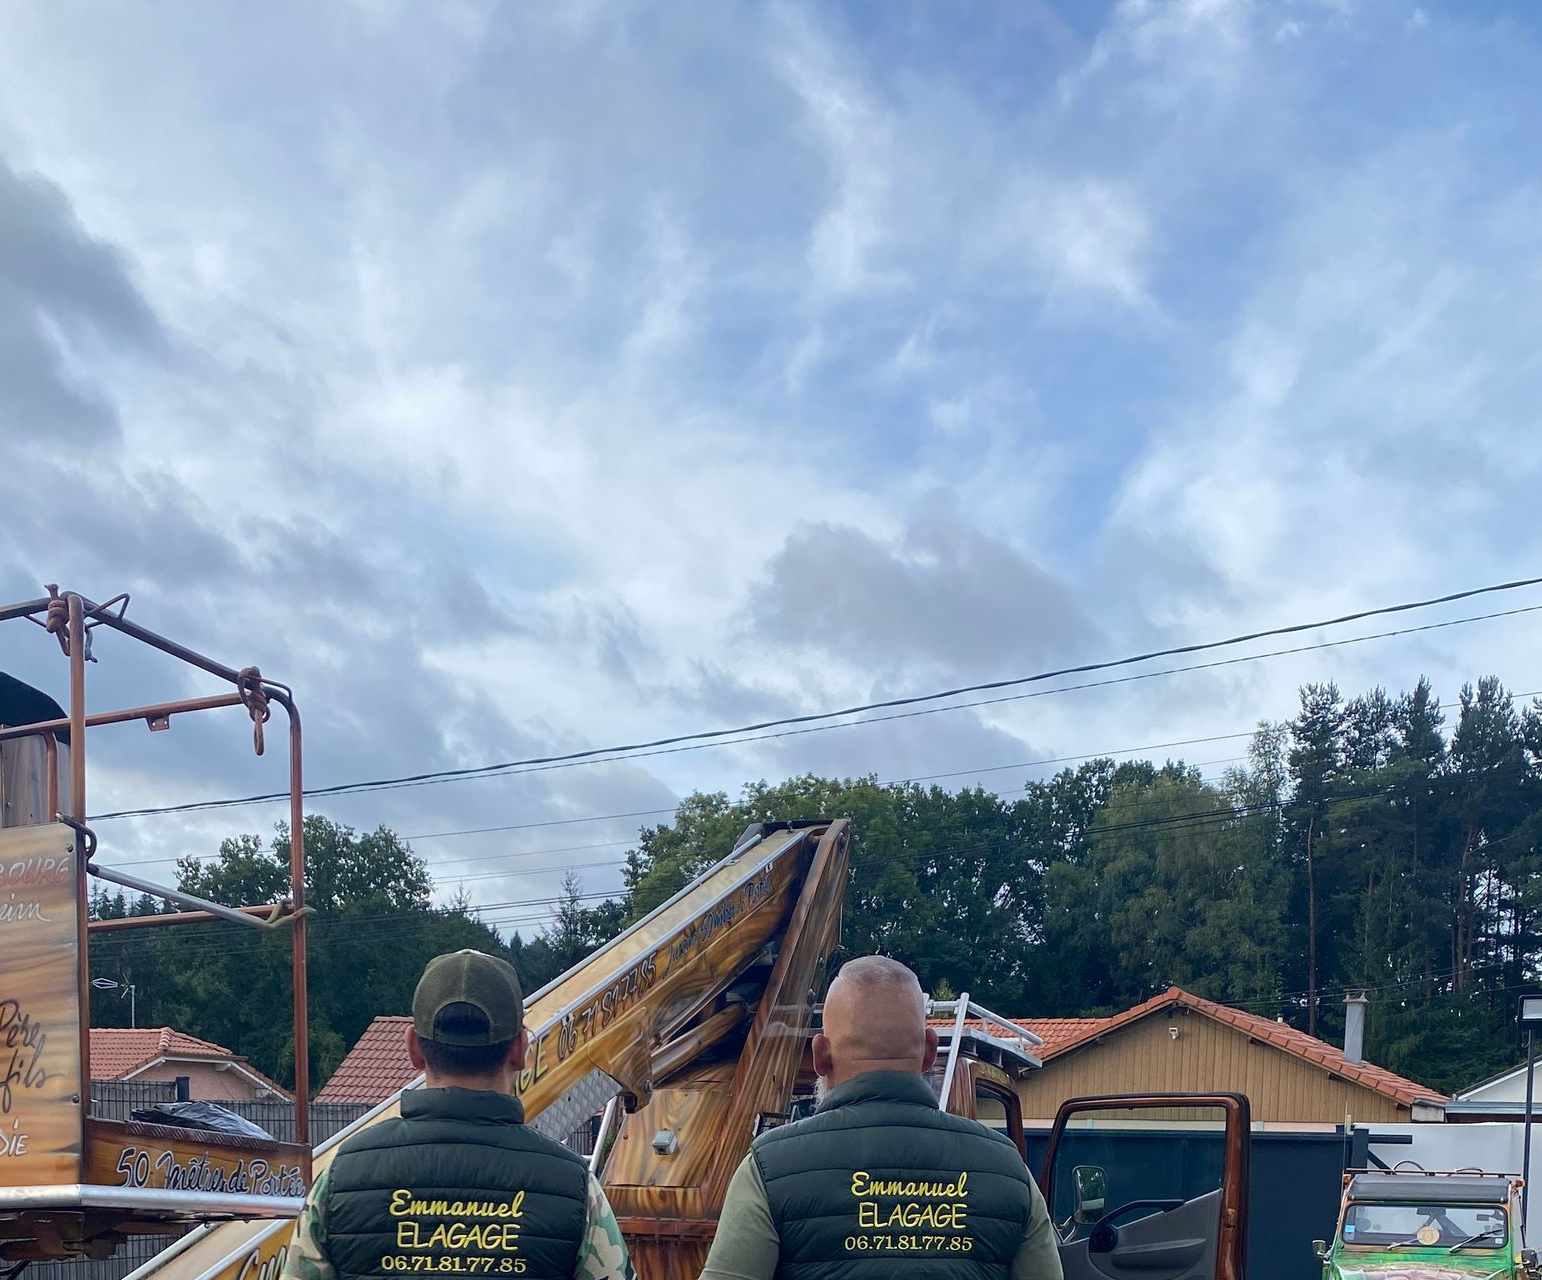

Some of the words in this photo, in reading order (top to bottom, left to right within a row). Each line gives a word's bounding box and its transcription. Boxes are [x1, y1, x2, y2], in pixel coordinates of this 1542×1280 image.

[117, 1146, 150, 1188] 50
[851, 1171, 968, 1197] Emmanuel
[389, 1189, 525, 1217] Emmanuel
[858, 1202, 968, 1229] ELAGAGE
[397, 1221, 521, 1250] ELAGAGE
[844, 1235, 974, 1251] 06.71.81.77.85
[381, 1255, 527, 1273] 06.71.81.77.85
